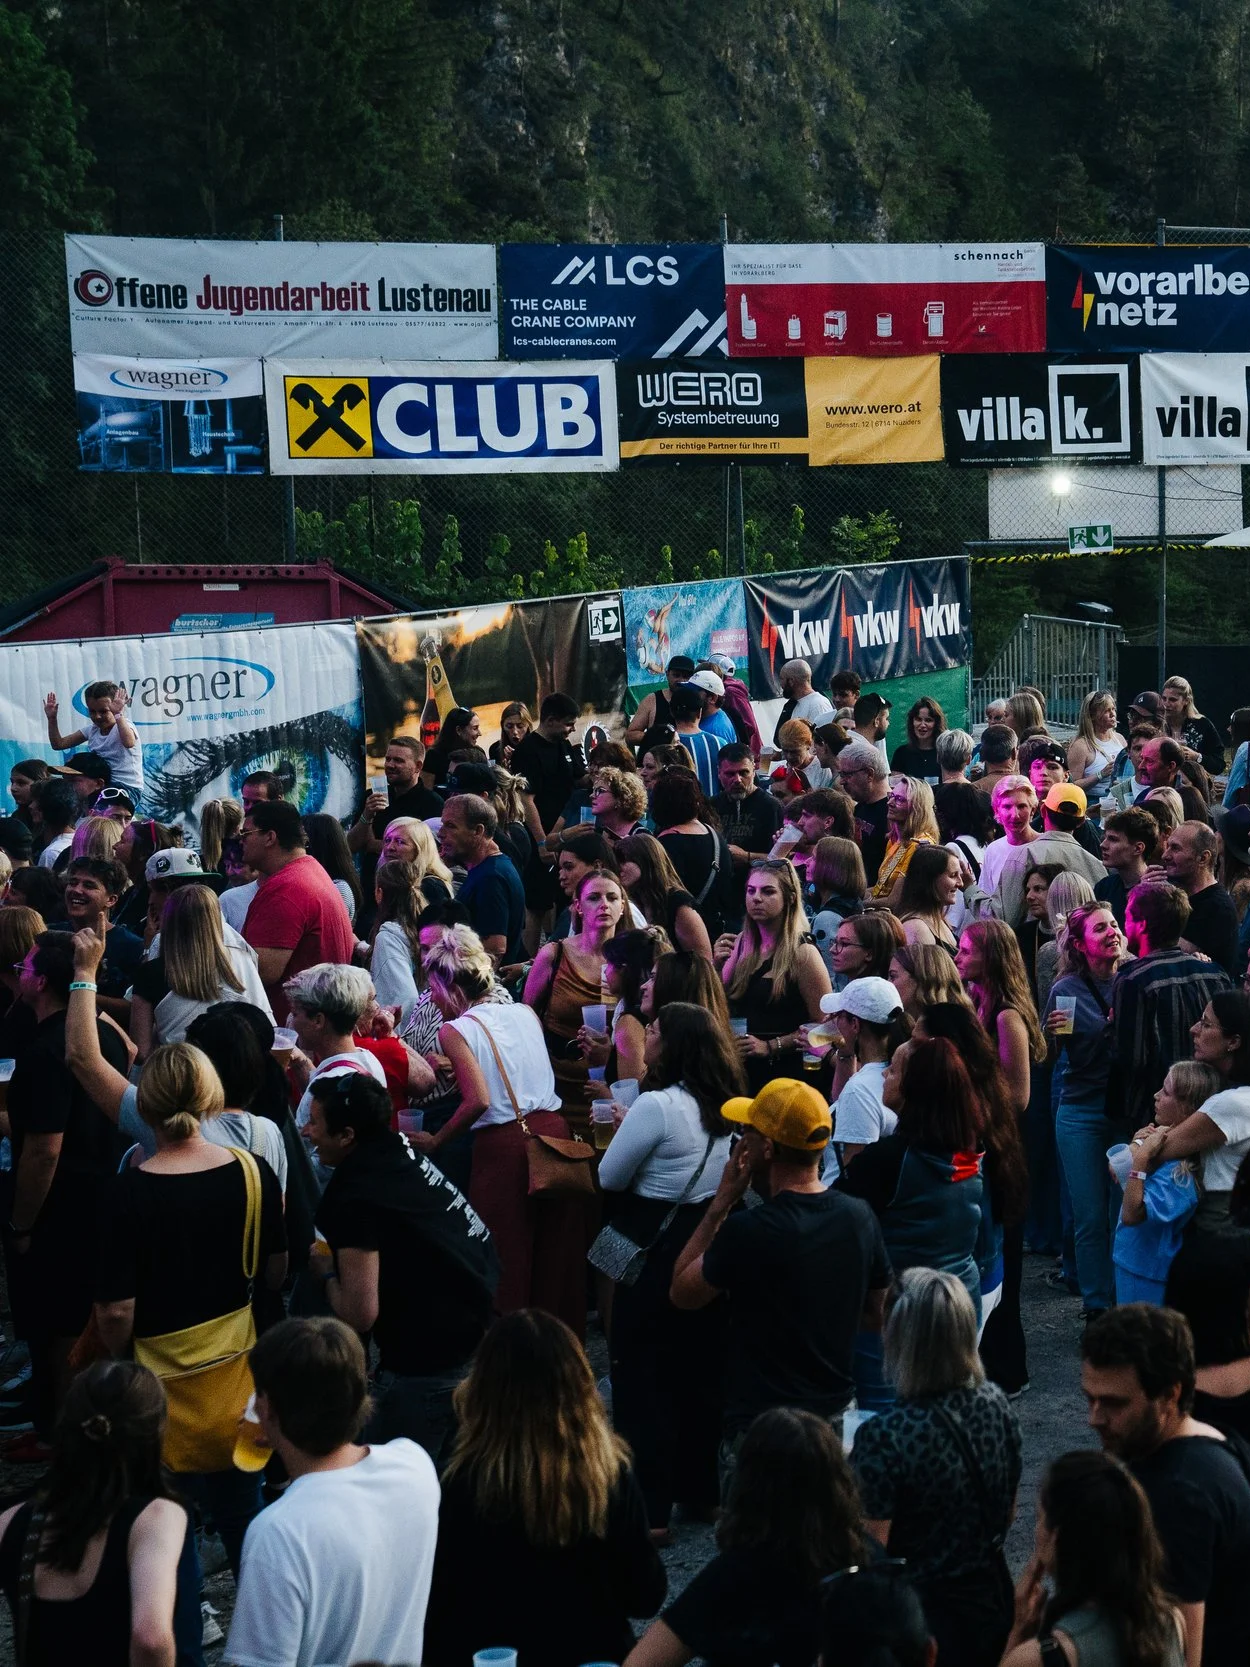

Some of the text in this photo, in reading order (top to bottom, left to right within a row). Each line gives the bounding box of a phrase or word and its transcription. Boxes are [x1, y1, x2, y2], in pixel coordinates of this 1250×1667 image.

[954, 250, 1024, 261] schennach
[605, 255, 679, 286] LCS
[74, 269, 491, 316] Offene Jugendarbeit Lustenau
[511, 299, 587, 310] THE CABLE
[511, 316, 637, 328] CRANE COMPANY
[1096, 296, 1177, 327] netz
[513, 336, 617, 346] lcs-cablecranes.com
[128, 370, 212, 390] wagner
[637, 372, 762, 407] WERO
[376, 382, 597, 454] CLUB
[657, 411, 780, 427] Systembetreuung
[825, 401, 922, 416] www.wero.at
[957, 396, 1103, 442] villa k.
[1155, 395, 1242, 438] villa
[825, 421, 860, 429] Bundesstr.
[659, 442, 780, 451] Der richtige Partner für Ihre IT!
[853, 600, 899, 648] vkw
[921, 593, 961, 638] vkw
[777, 609, 830, 659] vkw
[186, 707, 265, 722] www.wagnergmbh.com
